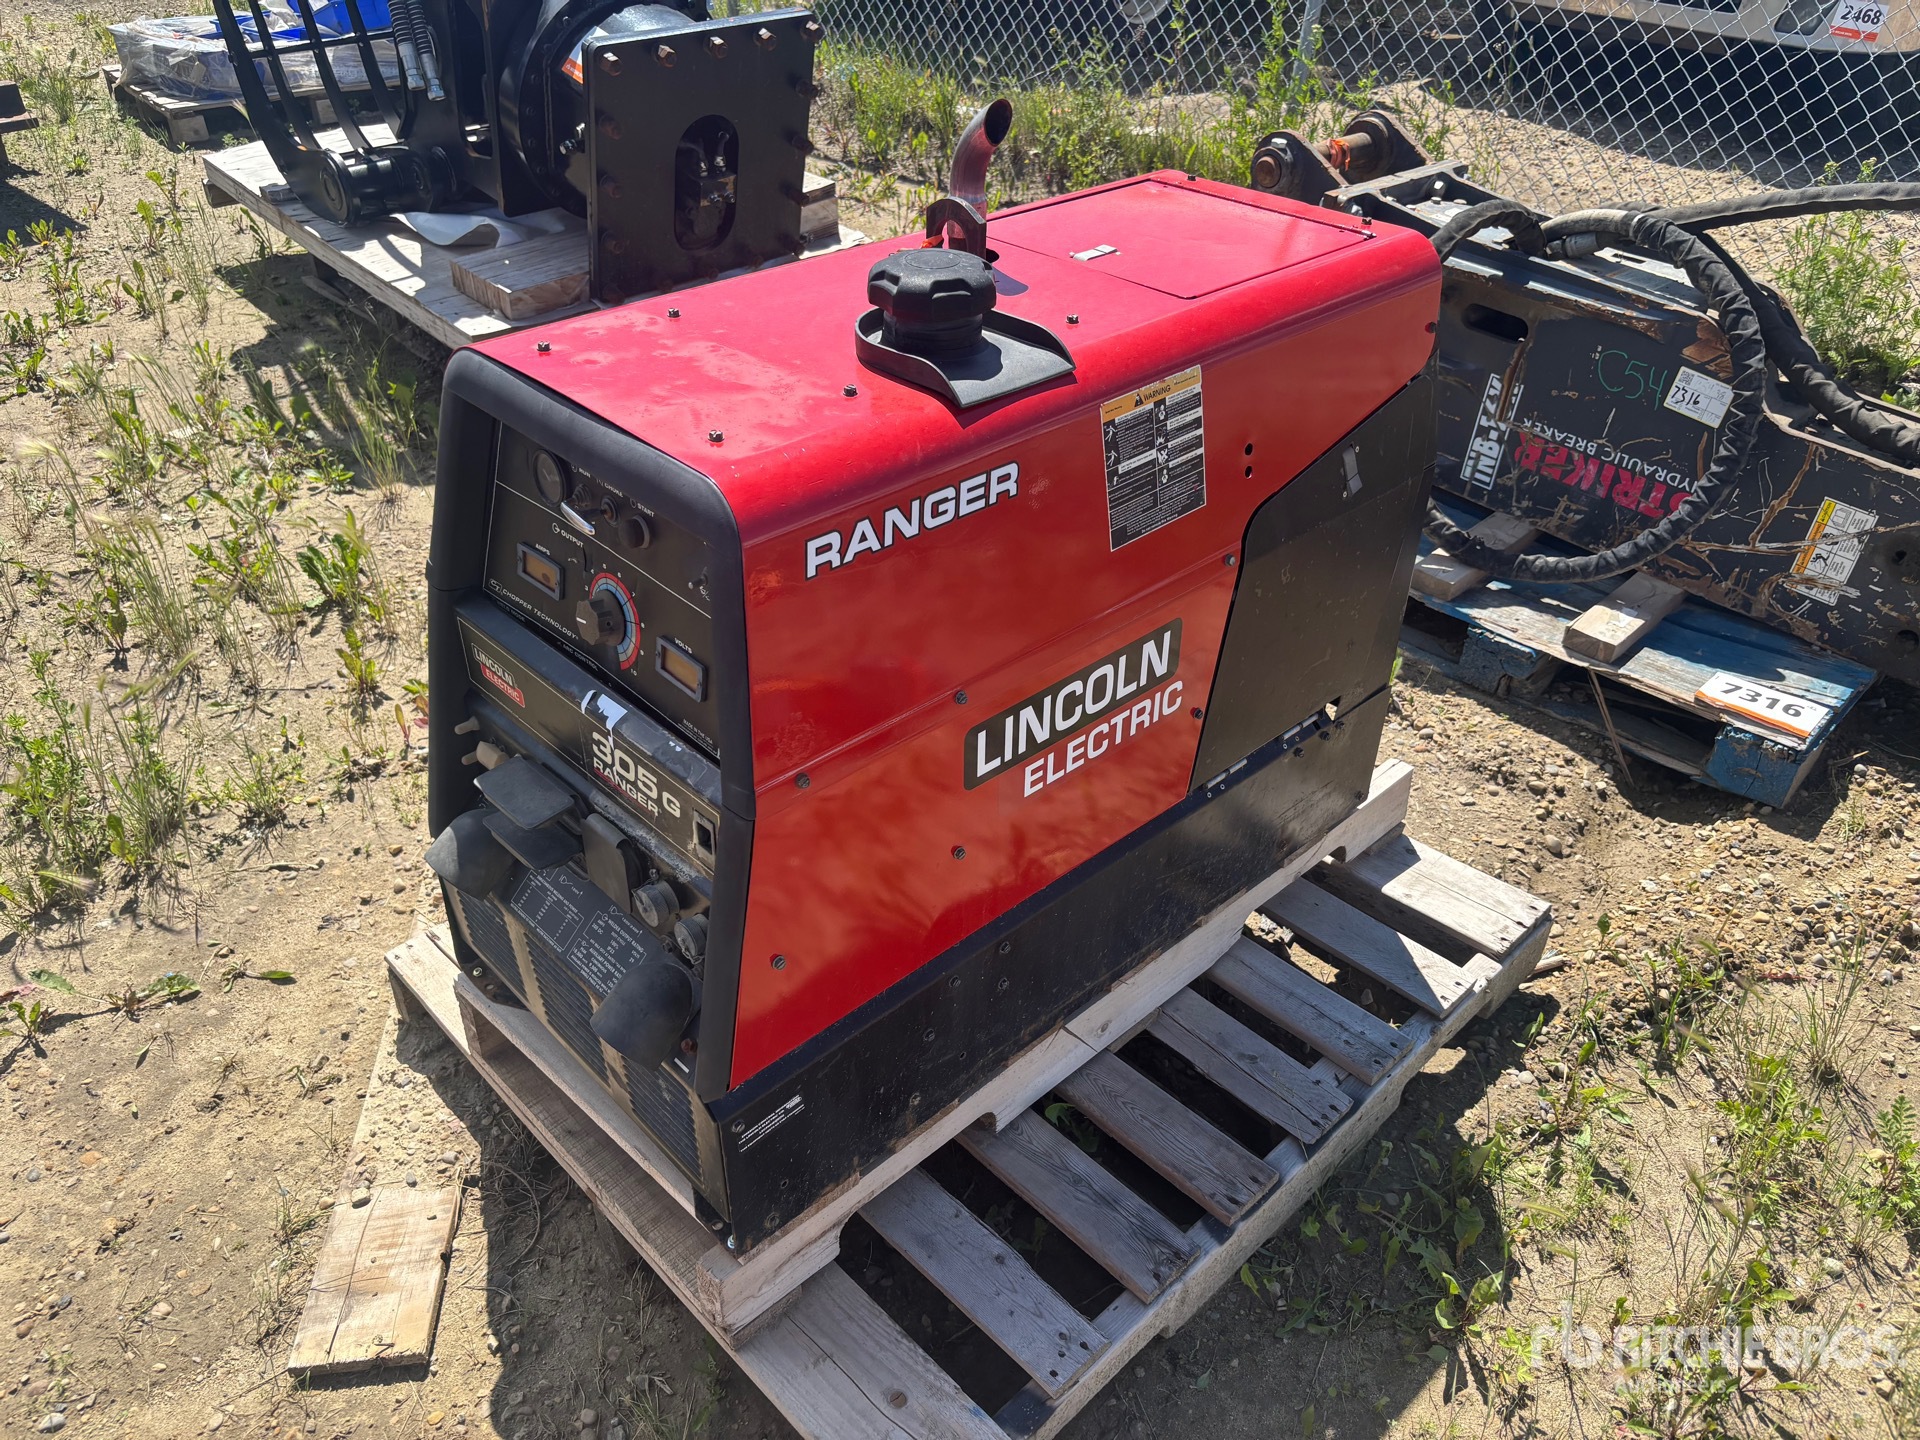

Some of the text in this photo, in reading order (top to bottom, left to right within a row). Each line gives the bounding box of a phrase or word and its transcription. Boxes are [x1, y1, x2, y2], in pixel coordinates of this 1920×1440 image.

[1841, 5, 1883, 25] 2468
[1143, 385, 1171, 402] WARNING
[1597, 350, 1668, 411] C54
[1671, 385, 1701, 406] 7316
[1522, 417, 1598, 456] BREAKER
[637, 503, 655, 518] START
[805, 460, 1019, 579] RANGER
[535, 542, 550, 556] AMPS
[561, 530, 584, 549] OUTPUT
[502, 588, 533, 611] CHOPPER
[574, 652, 598, 671] CONTROL
[674, 637, 693, 654] VOLTS
[474, 647, 513, 687] LINCOLN
[486, 669, 520, 702] ELECTRIC
[1720, 682, 1805, 718] 7316
[976, 630, 1171, 778] LINCOLN
[1024, 680, 1183, 798] ELECTRIC
[592, 731, 658, 800] 305
[662, 792, 681, 818] G
[593, 757, 659, 817] RANGER
[608, 919, 643, 953] WELDER OUTPUT RATING
[604, 961, 615, 972] POWER
